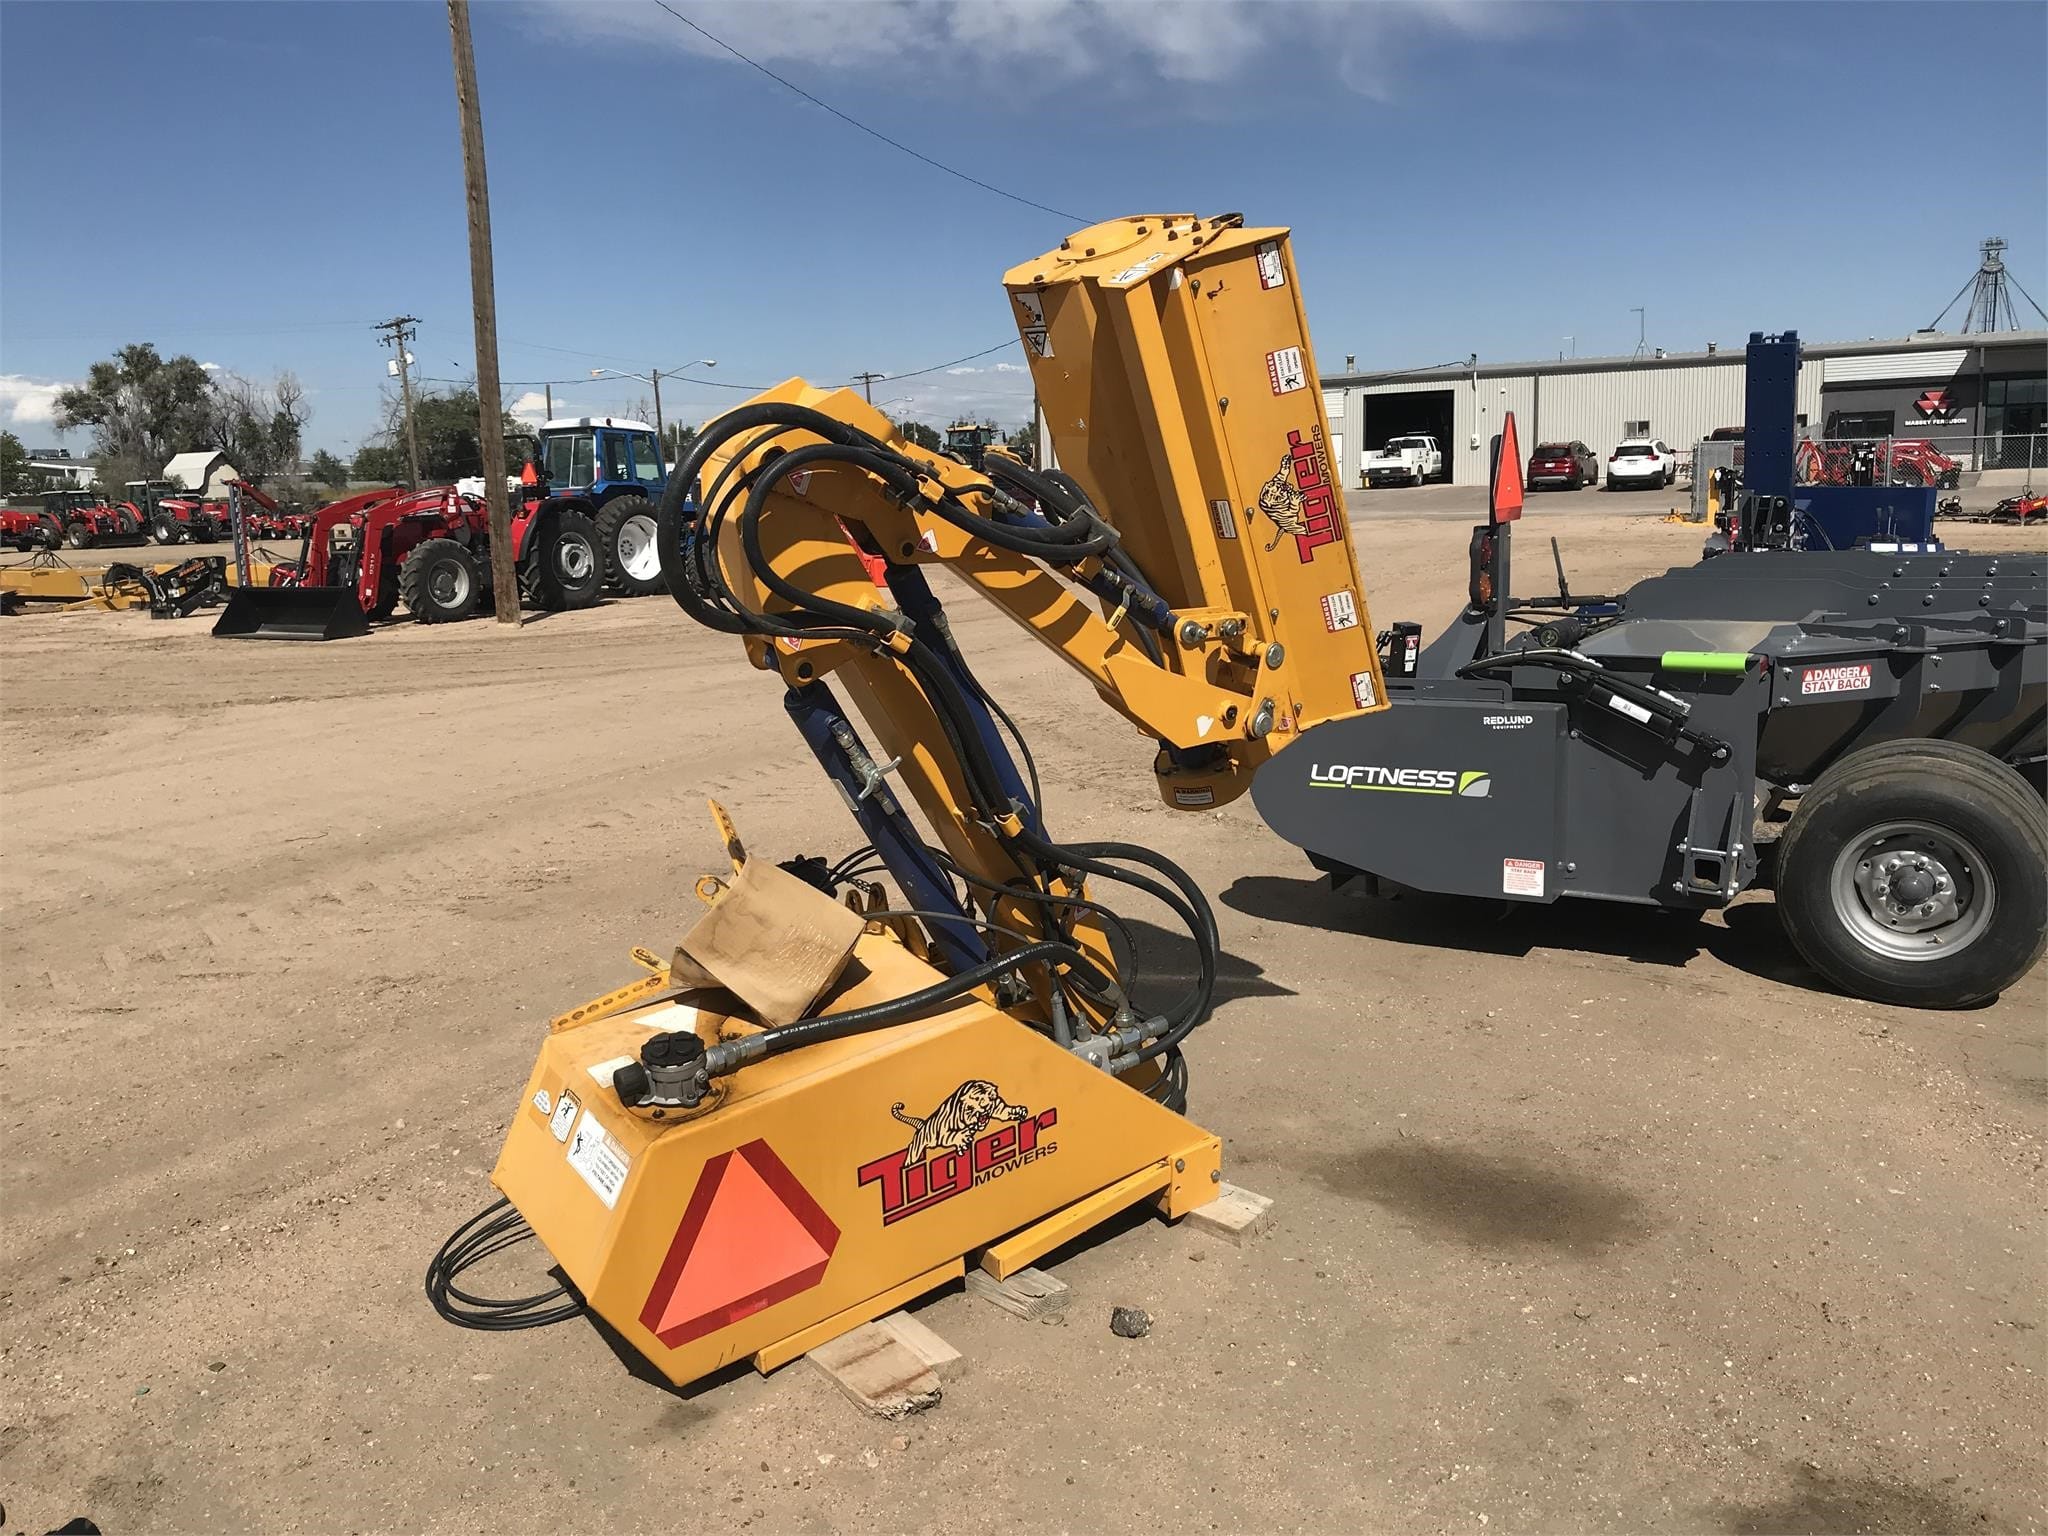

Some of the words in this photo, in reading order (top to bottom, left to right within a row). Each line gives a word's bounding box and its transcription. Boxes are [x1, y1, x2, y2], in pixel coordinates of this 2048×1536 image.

[1267, 354, 1279, 388] DANGER
[1311, 424, 1331, 483] MOWERS
[1287, 430, 1343, 564] Tiger
[1321, 597, 1334, 625] DANGER
[1804, 681, 1834, 693] STAY
[1837, 678, 1867, 690] BACK
[1814, 666, 1860, 681] DANGER
[1483, 715, 1533, 725] REDLUND
[1310, 763, 1457, 788] LOFTNESS
[1514, 861, 1541, 869] DANGER
[858, 1107, 1057, 1227] Tiger
[974, 1141, 1058, 1188] MOWERS
